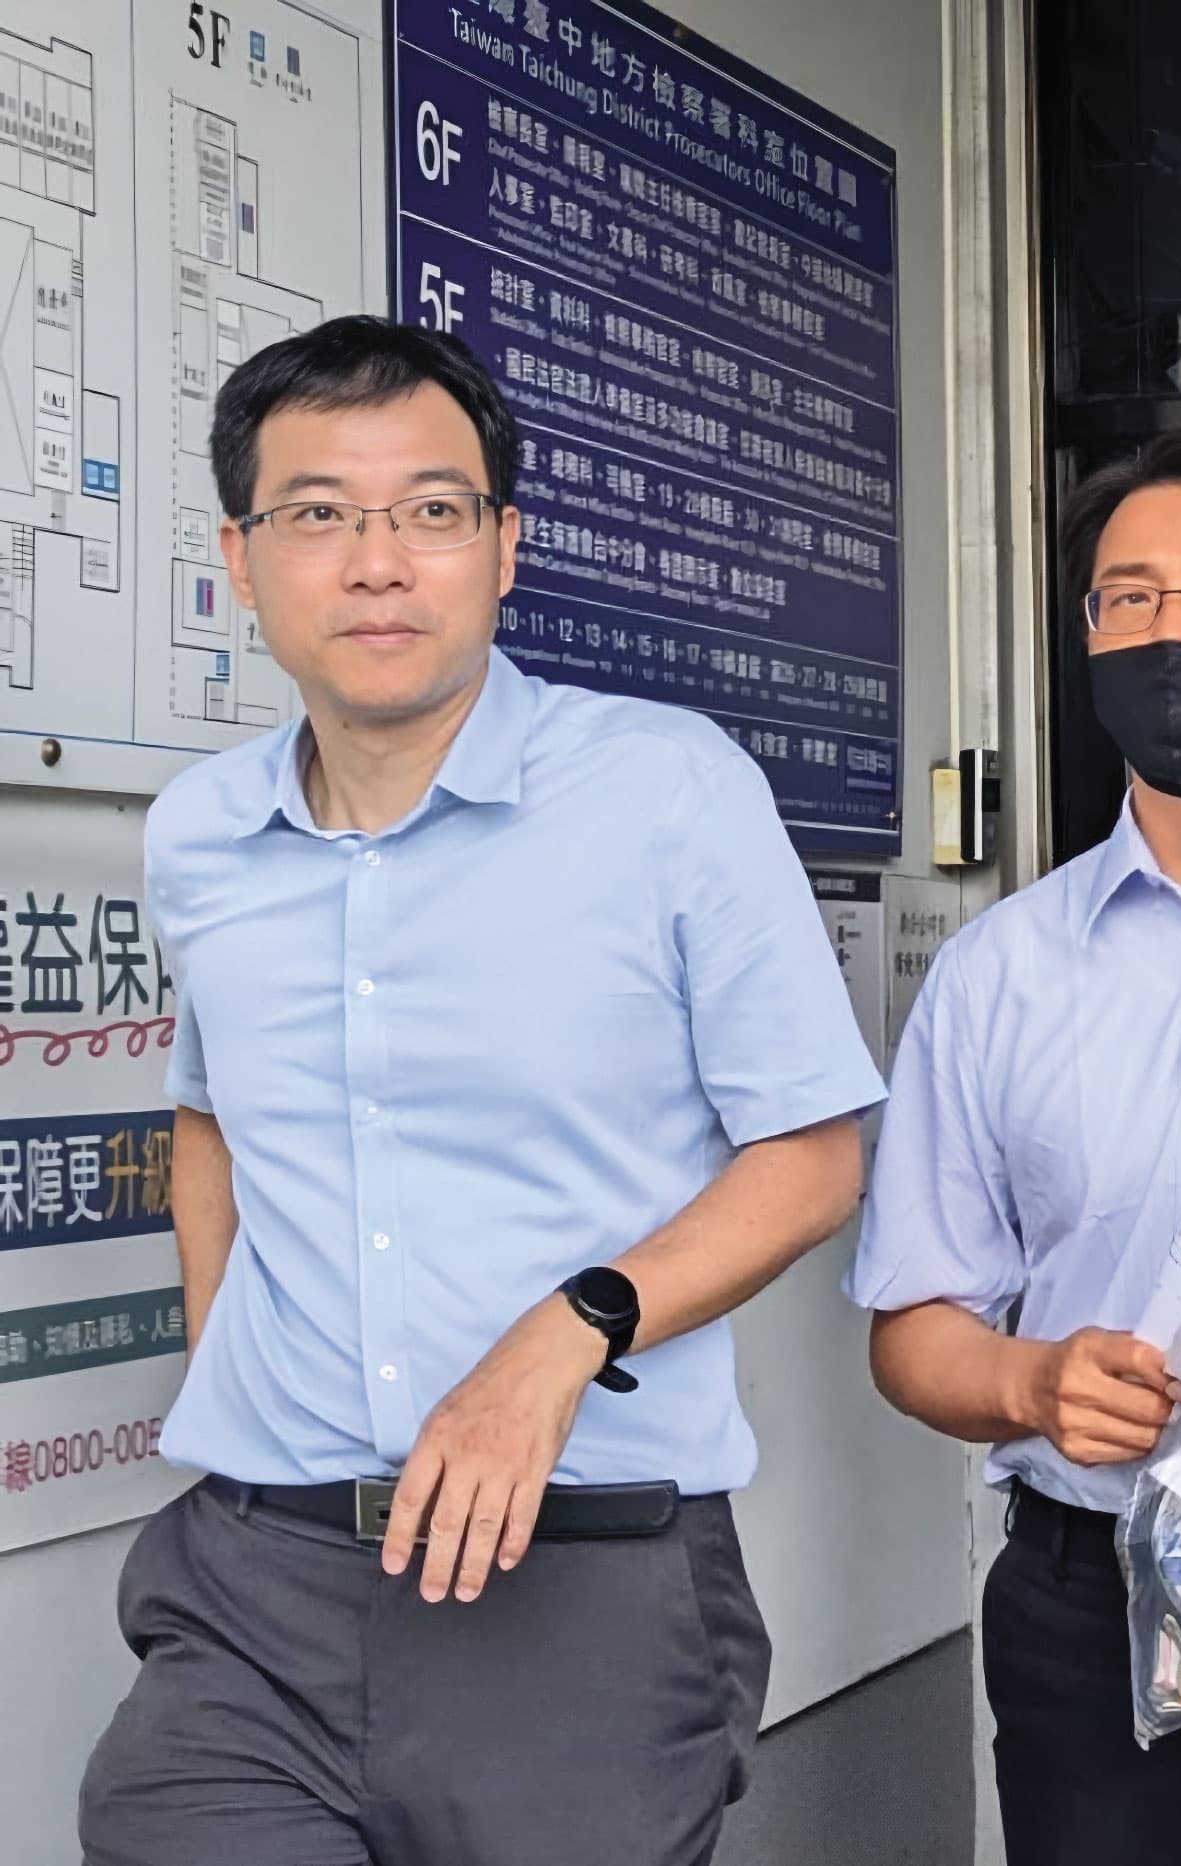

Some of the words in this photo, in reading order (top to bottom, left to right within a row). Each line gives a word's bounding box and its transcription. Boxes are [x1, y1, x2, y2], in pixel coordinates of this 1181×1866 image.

[187, 2, 231, 68] 5F
[416, 101, 463, 186] 6F
[449, 8, 514, 66] Taiwan
[519, 44, 597, 114] Taichung
[602, 88, 660, 141] District
[755, 168, 796, 208] Office
[420, 262, 465, 333] 5F
[0, 891, 176, 1017] 益保
